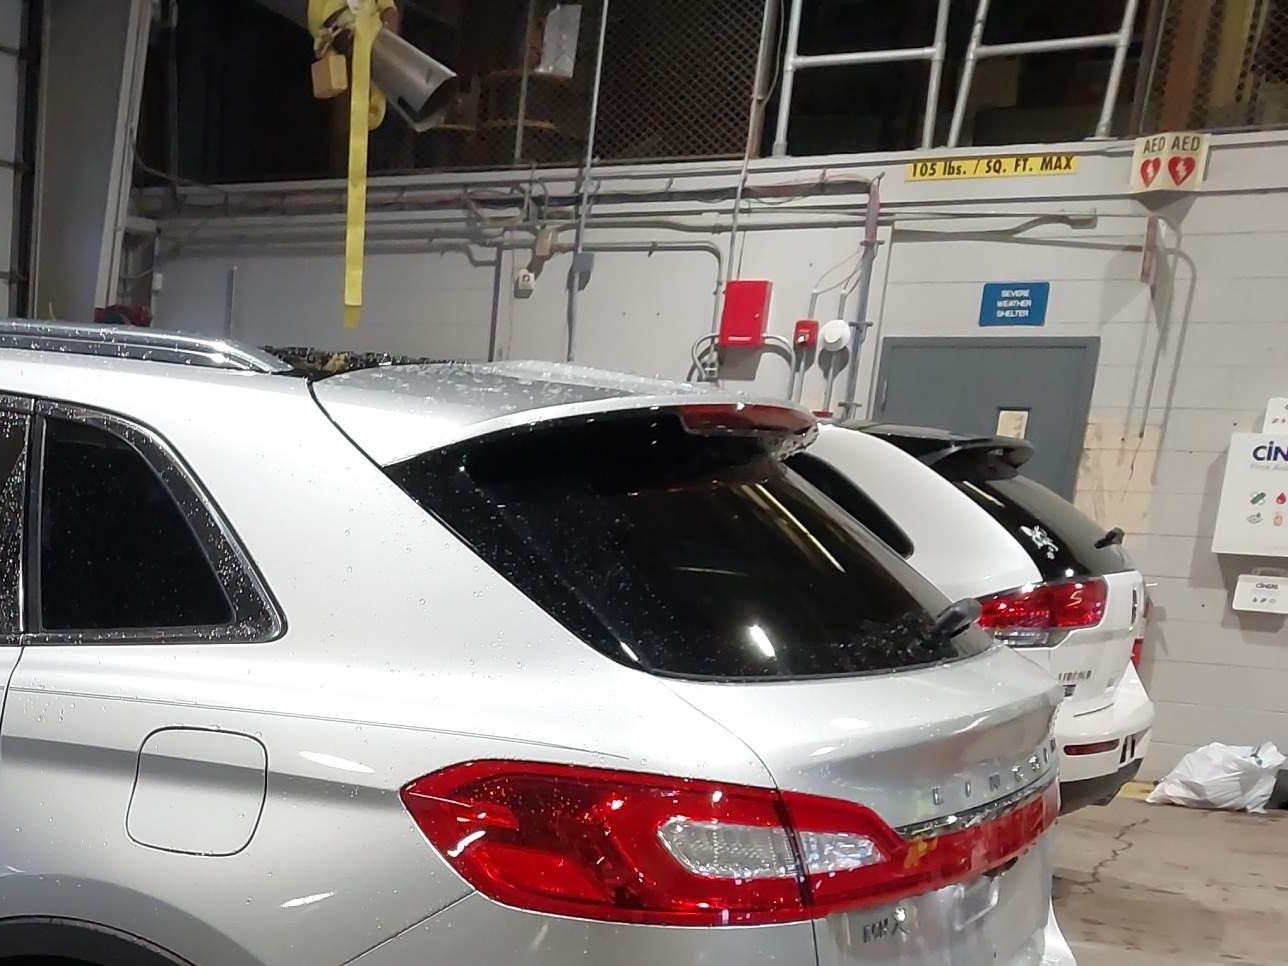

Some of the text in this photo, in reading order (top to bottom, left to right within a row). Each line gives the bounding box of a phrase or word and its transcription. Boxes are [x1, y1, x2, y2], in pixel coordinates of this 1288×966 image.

[1143, 136, 1166, 154] AED
[1172, 135, 1201, 152] AED
[913, 162, 938, 177] 105
[943, 161, 967, 176] lbs.
[985, 159, 1007, 174] SQ.
[1014, 158, 1034, 172] FT.
[1040, 155, 1075, 171] MAX
[1000, 289, 1031, 298] SEVERE
[996, 299, 1032, 308] WEATHER
[996, 309, 1030, 318] SHELTER
